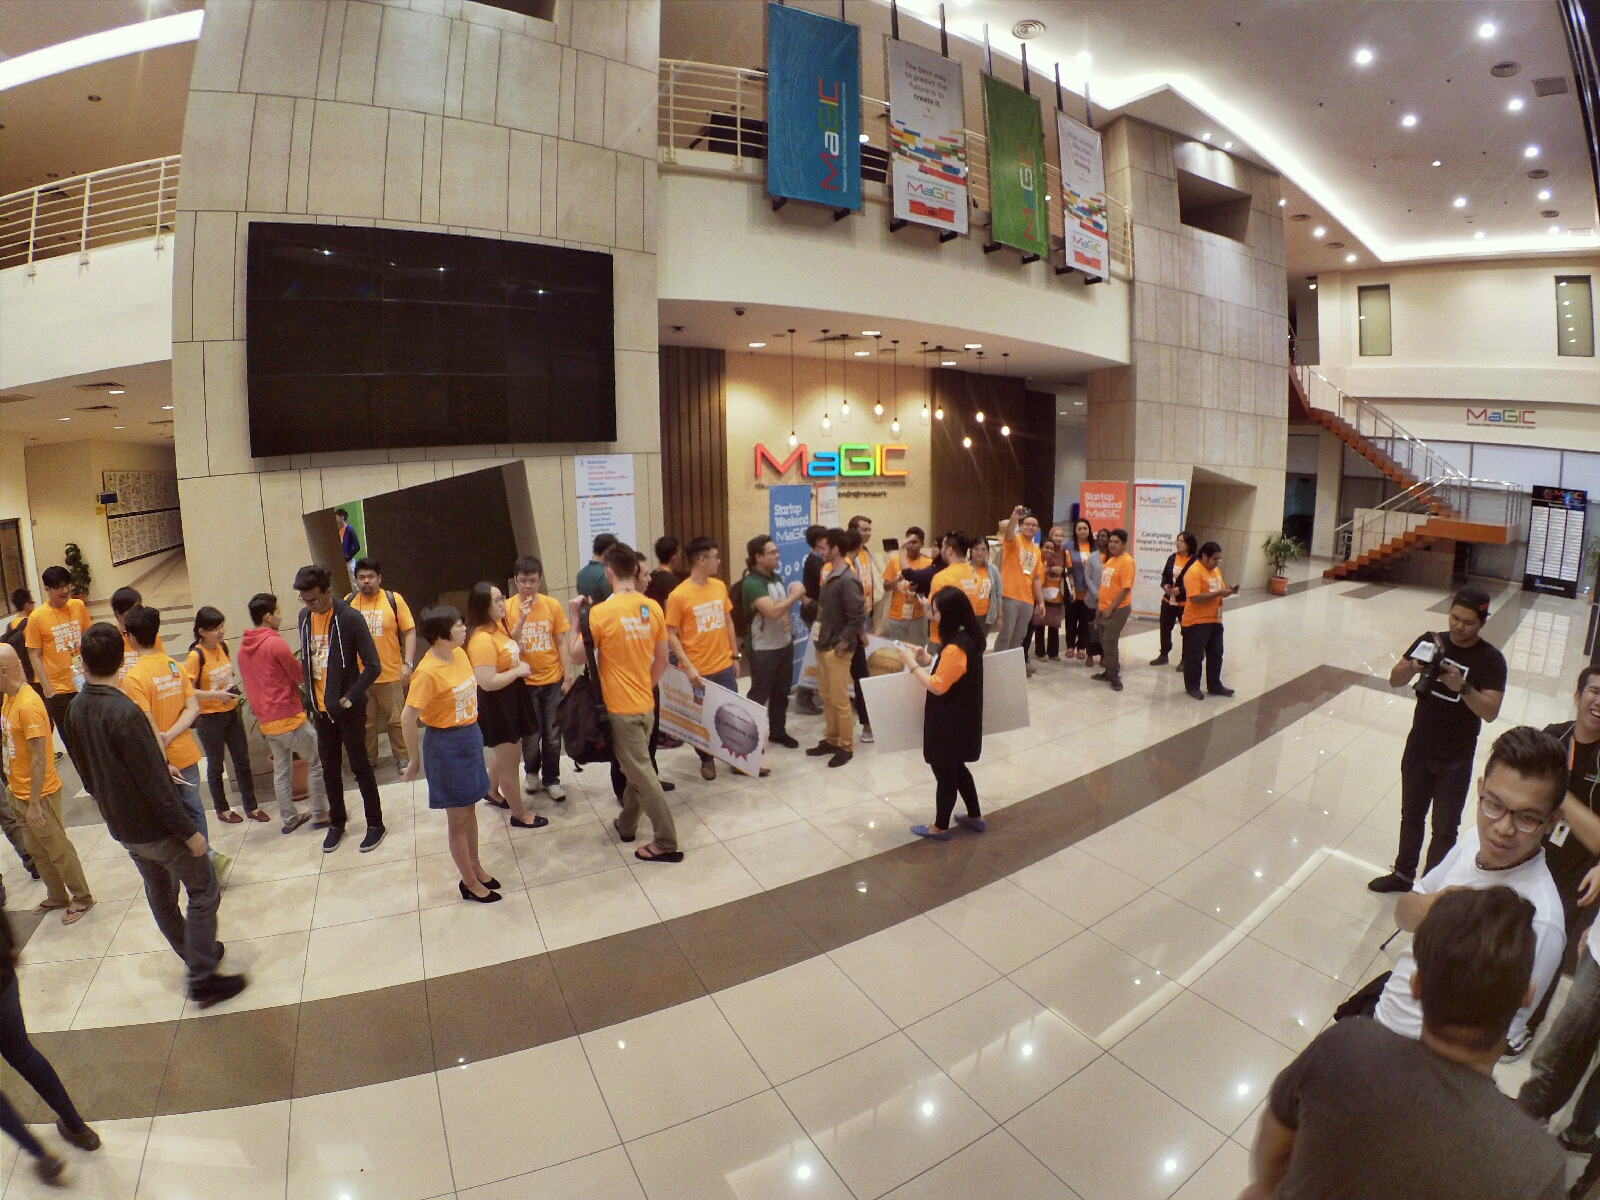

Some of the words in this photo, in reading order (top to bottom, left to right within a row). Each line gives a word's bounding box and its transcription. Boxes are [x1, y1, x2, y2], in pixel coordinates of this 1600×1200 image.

[905, 61, 917, 71] The
[917, 66, 933, 77] best
[913, 75, 936, 87] predict
[909, 82, 930, 94] future
[913, 93, 934, 105] create
[817, 76, 840, 191] MaGIC
[907, 181, 955, 203] MaGIC
[1467, 408, 1536, 425] MaGIC
[754, 442, 909, 477] MaGIC
[1084, 492, 1115, 502] Startup
[1139, 496, 1178, 505] MaGIC
[773, 503, 802, 516] Startup
[1084, 500, 1122, 509] Weekend
[1085, 509, 1121, 518] MaGIC
[774, 514, 809, 528] Weekend
[521, 627, 544, 635] ORLD
[521, 633, 550, 643] ETTER
[523, 640, 551, 652] LACE
